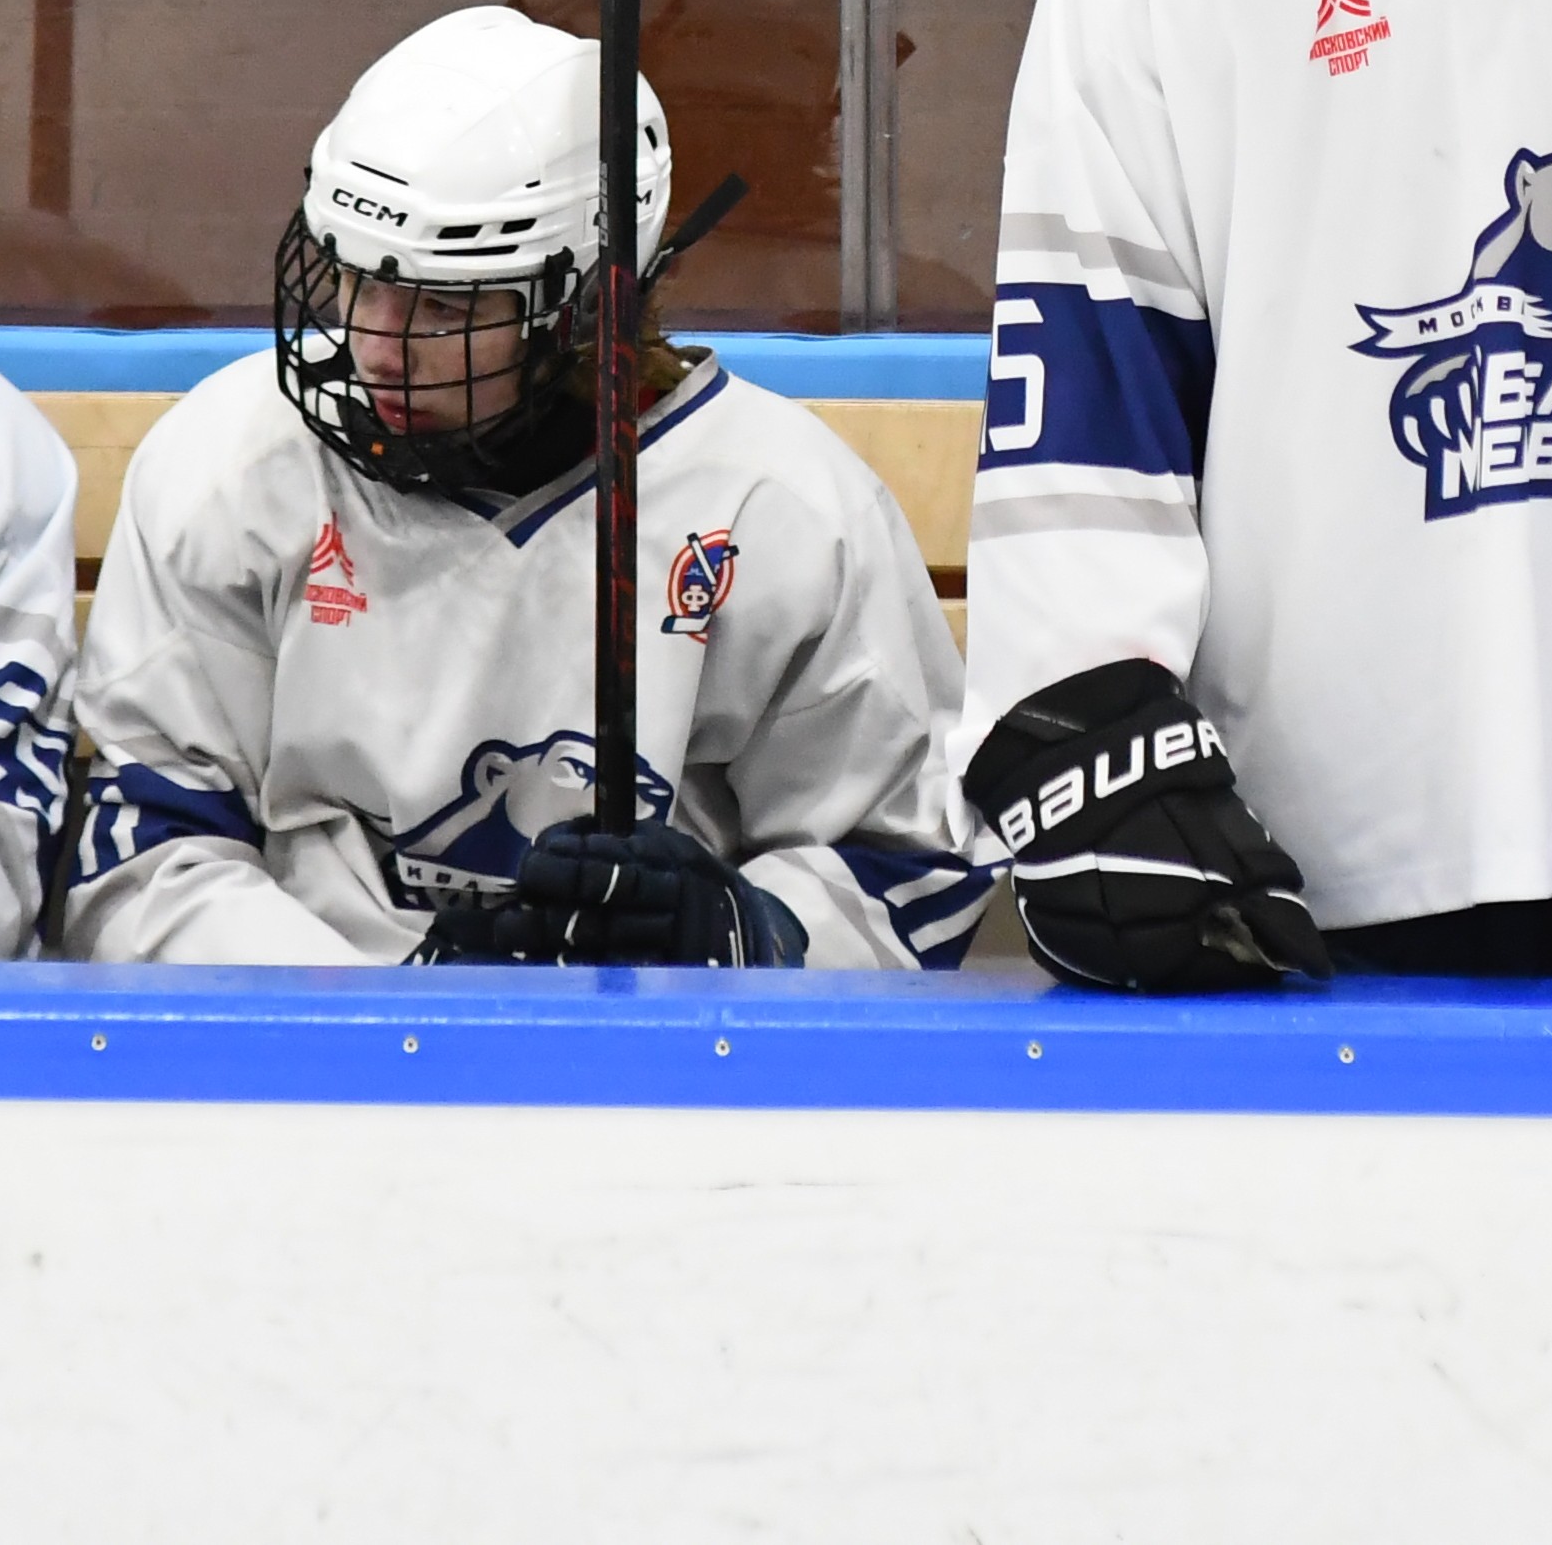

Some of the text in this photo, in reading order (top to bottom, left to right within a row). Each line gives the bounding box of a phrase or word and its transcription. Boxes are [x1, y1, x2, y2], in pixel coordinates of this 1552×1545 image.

[1327, 47, 1370, 77] СПОРТ
[332, 187, 409, 228] CCM
[980, 299, 1045, 454] 5
[998, 717, 1228, 853] BAUER
